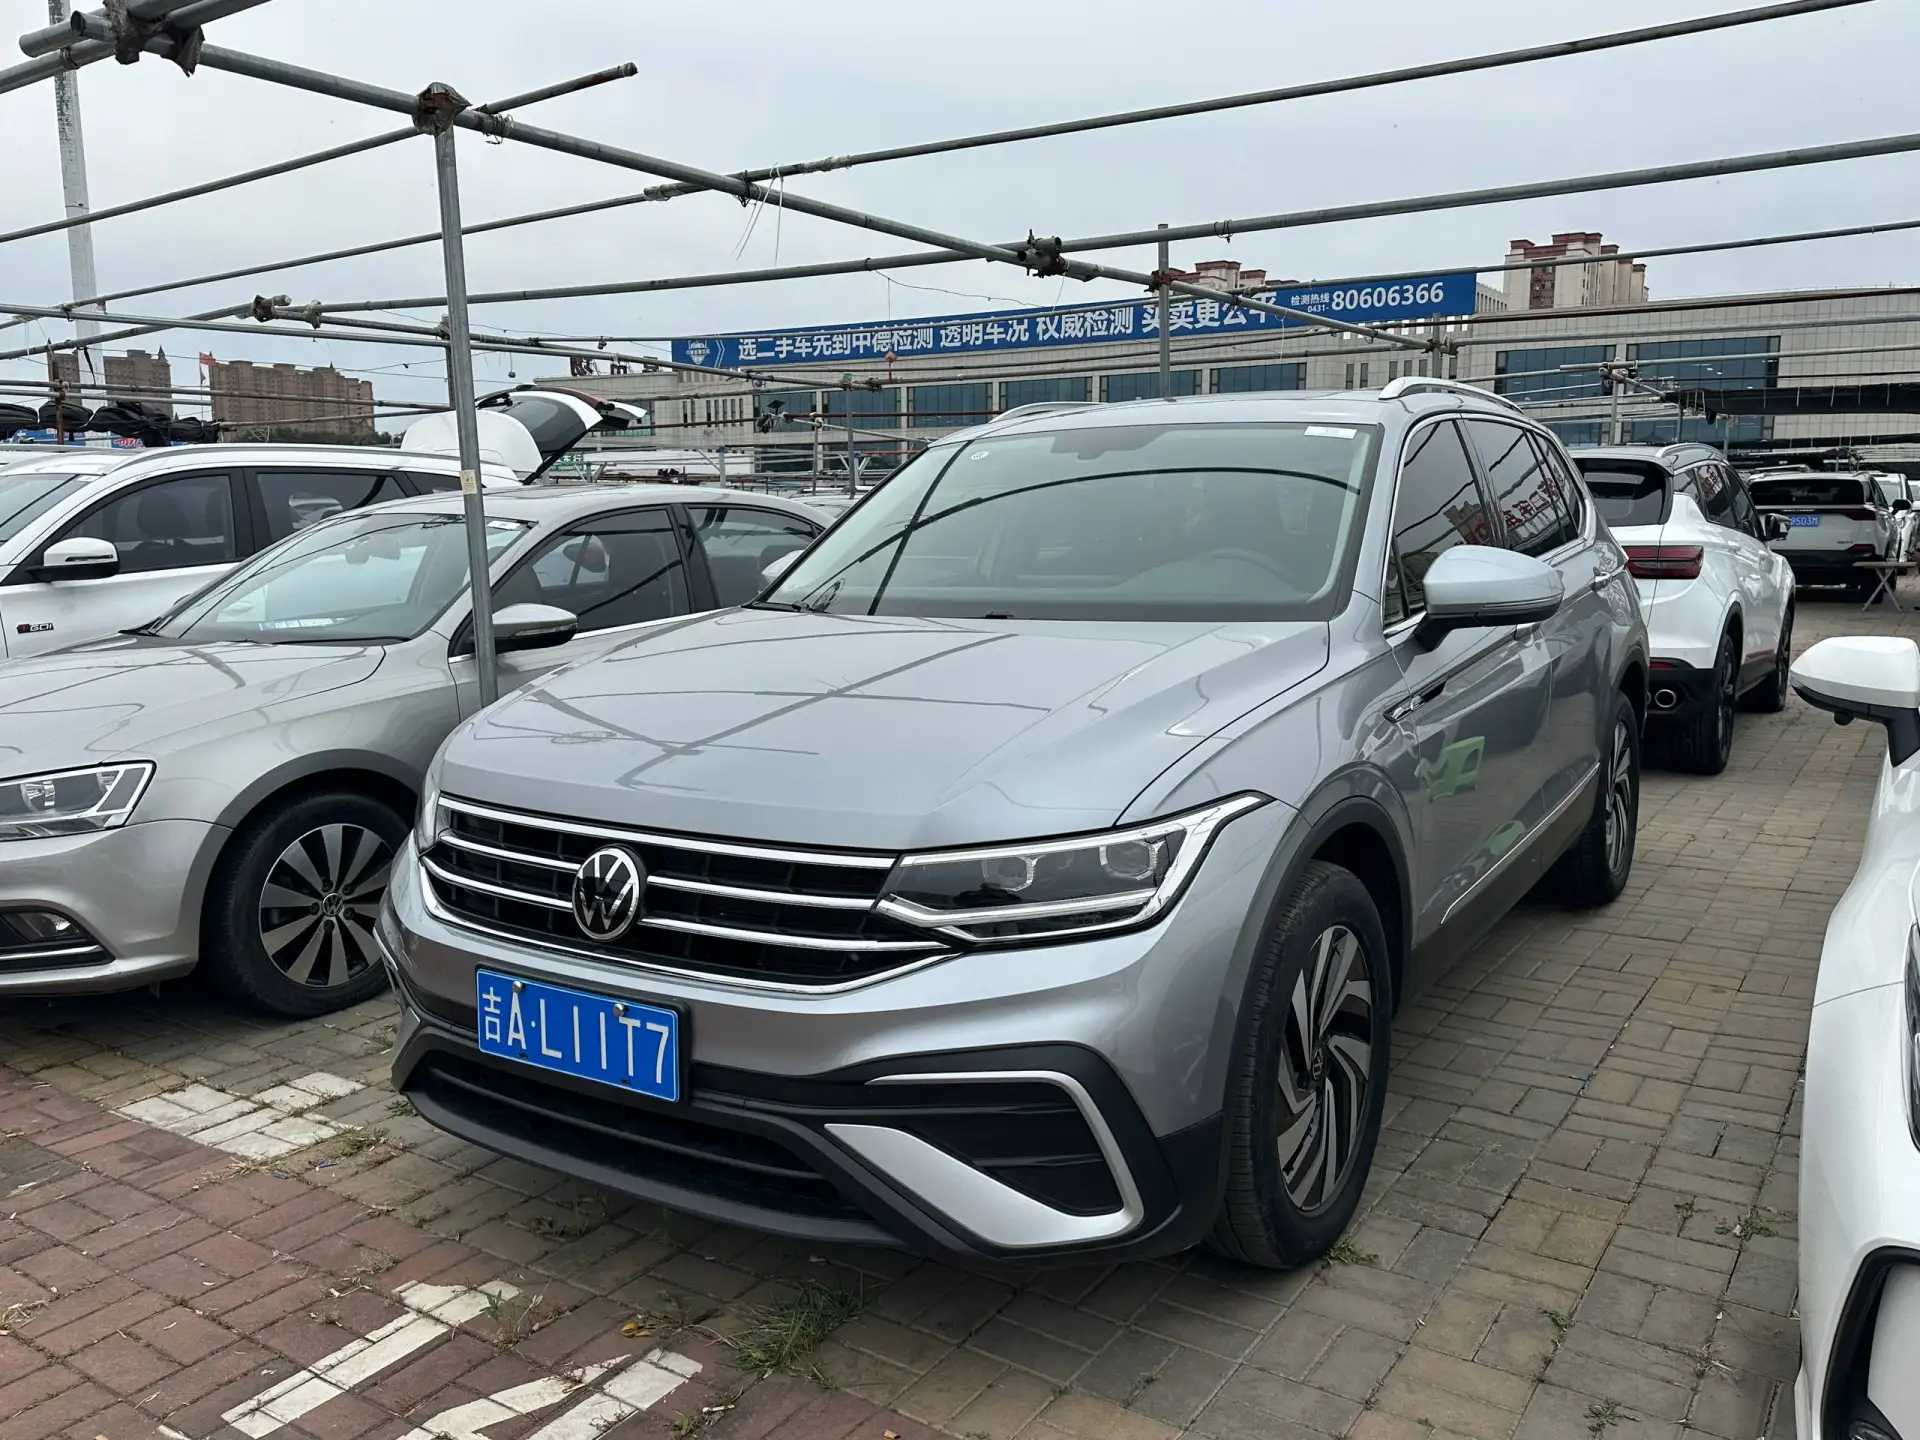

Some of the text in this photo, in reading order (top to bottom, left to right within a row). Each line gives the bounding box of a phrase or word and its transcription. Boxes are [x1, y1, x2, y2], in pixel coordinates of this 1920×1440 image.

[1290, 293, 1330, 306] 检测热线
[1307, 281, 1444, 313] 0431- 80606366
[738, 323, 933, 361] 选二手车先到中德检测
[940, 314, 1030, 348] 透明车况
[1036, 306, 1134, 341] 权威检测
